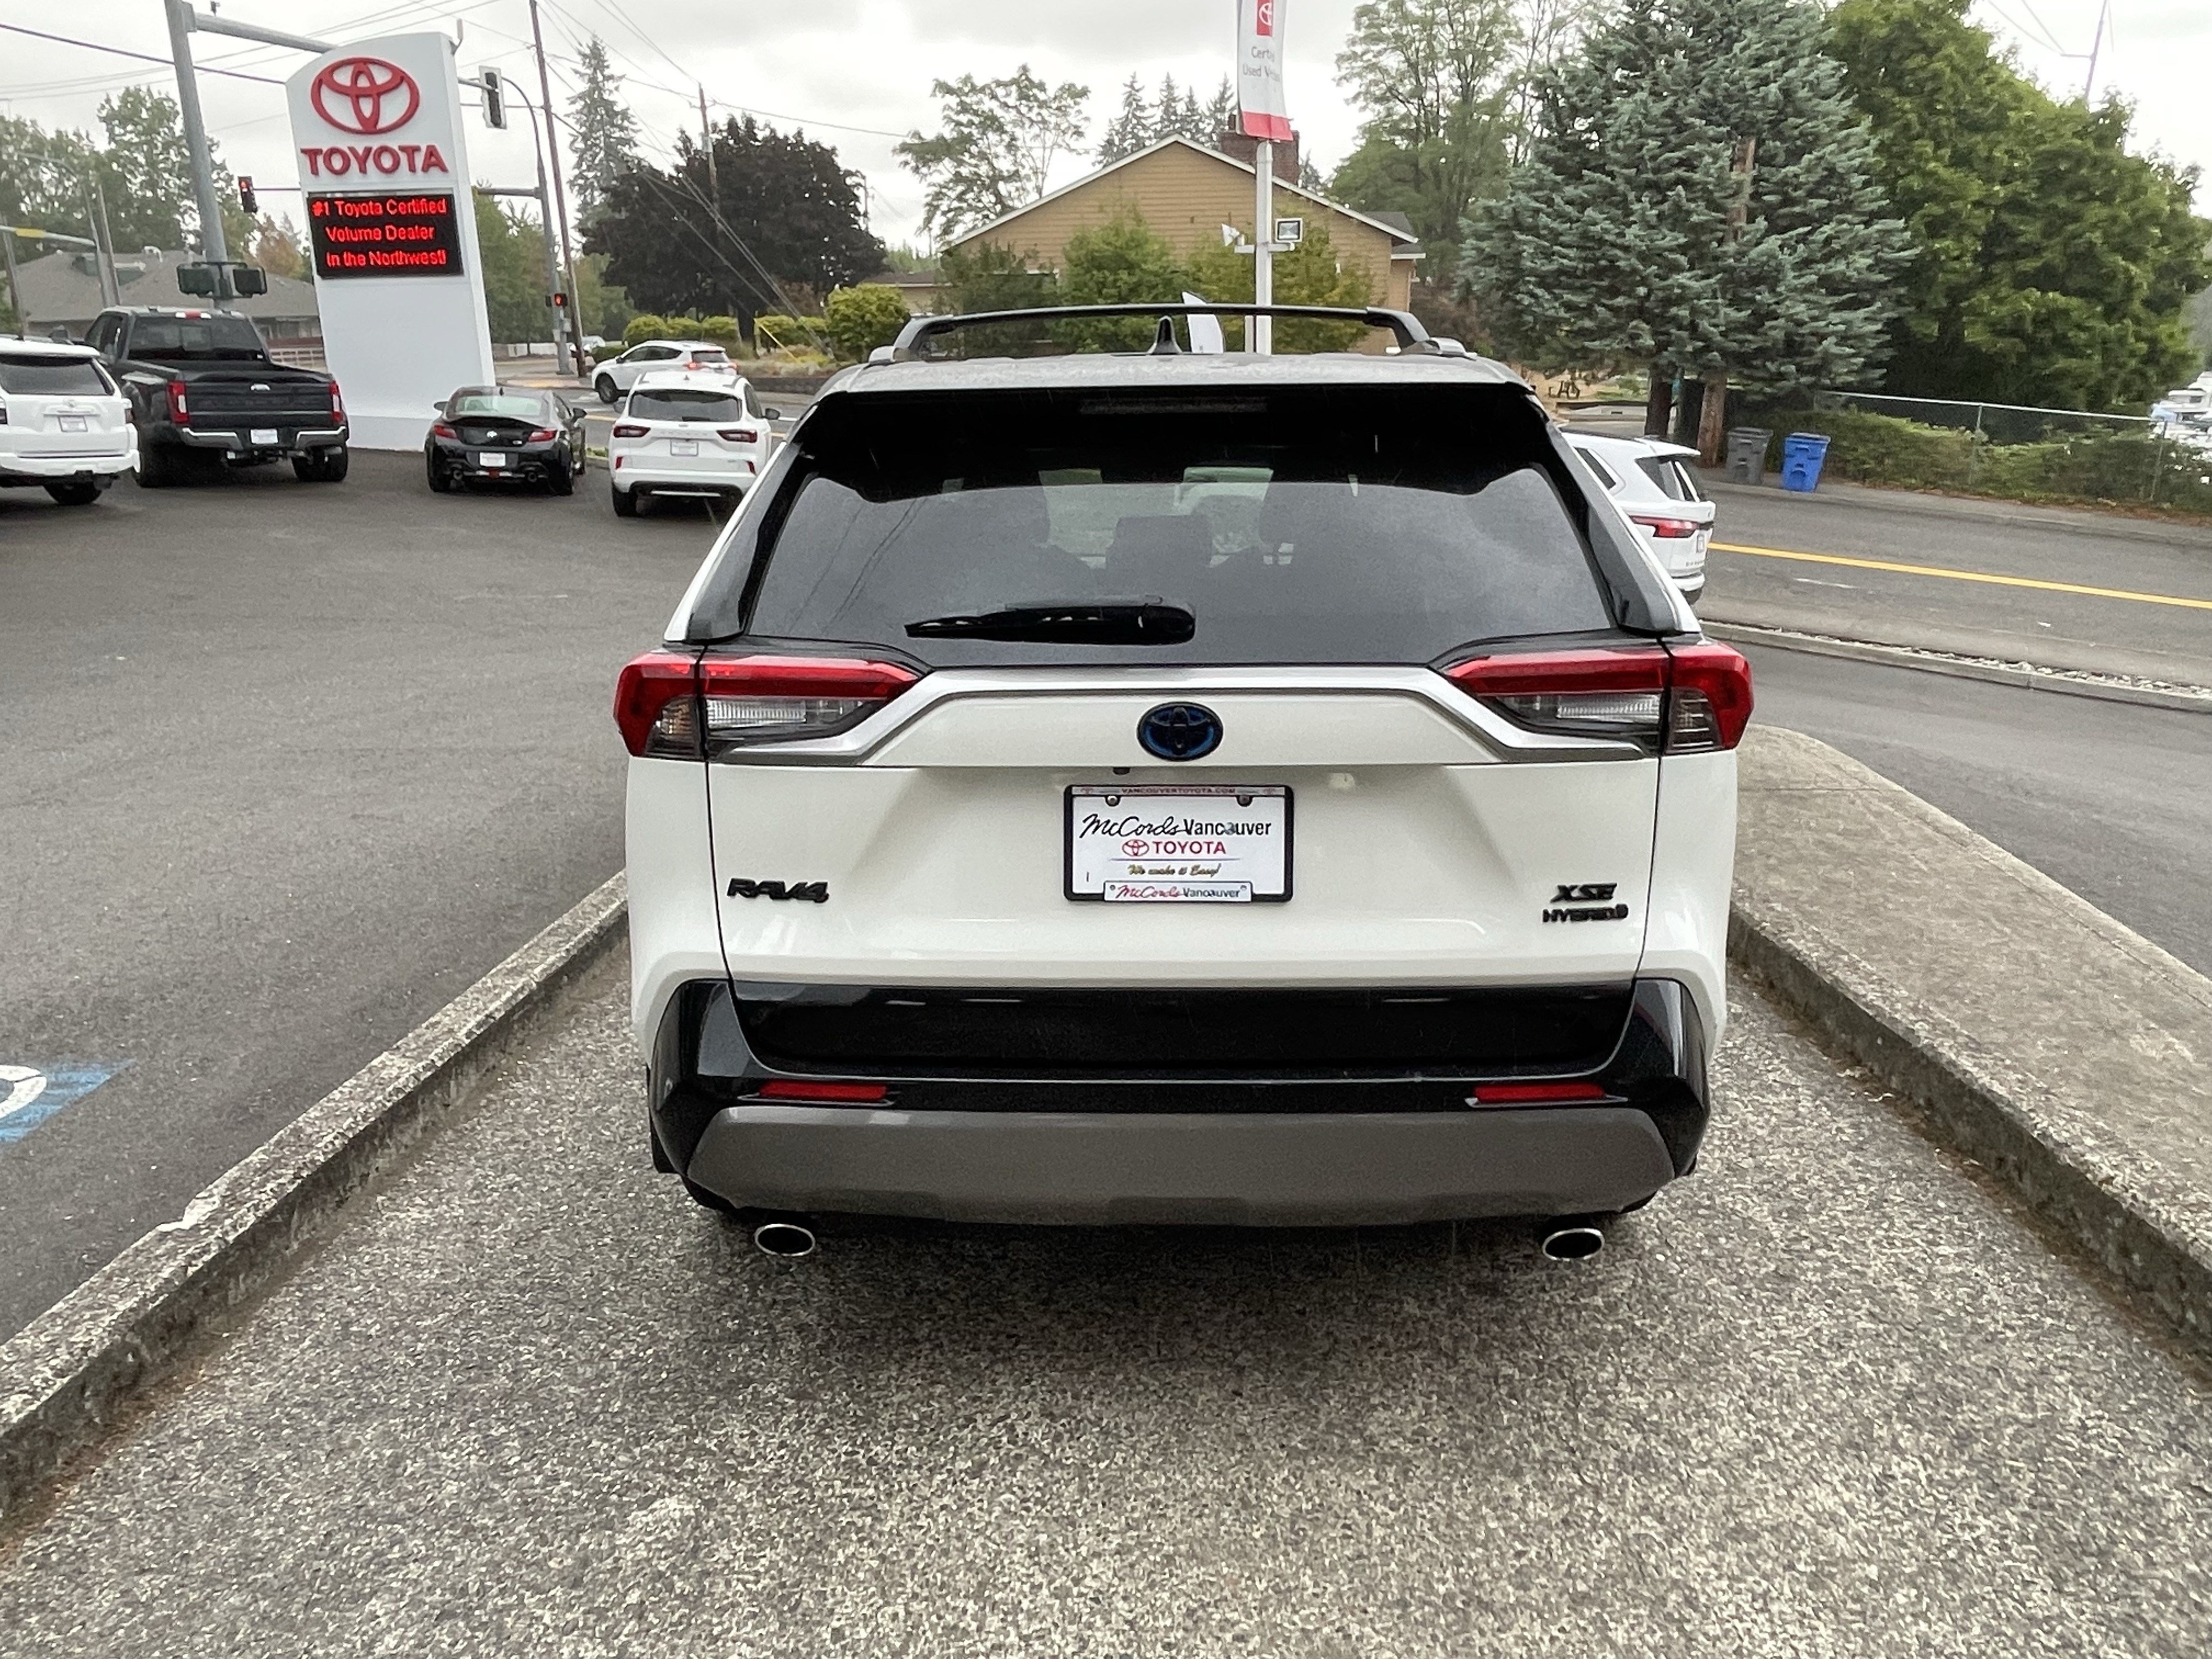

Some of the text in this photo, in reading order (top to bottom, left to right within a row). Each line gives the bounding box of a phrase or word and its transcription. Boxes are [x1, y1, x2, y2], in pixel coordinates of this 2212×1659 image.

[301, 145, 448, 176] TOYOTA
[334, 200, 383, 218] Toyota
[386, 198, 447, 215] Certified
[325, 224, 435, 242] Volume Dealer
[343, 251, 366, 266] the
[1152, 841, 1227, 855] TOYOTA
[727, 878, 830, 902] RAV4
[1550, 883, 1617, 903] XSE
